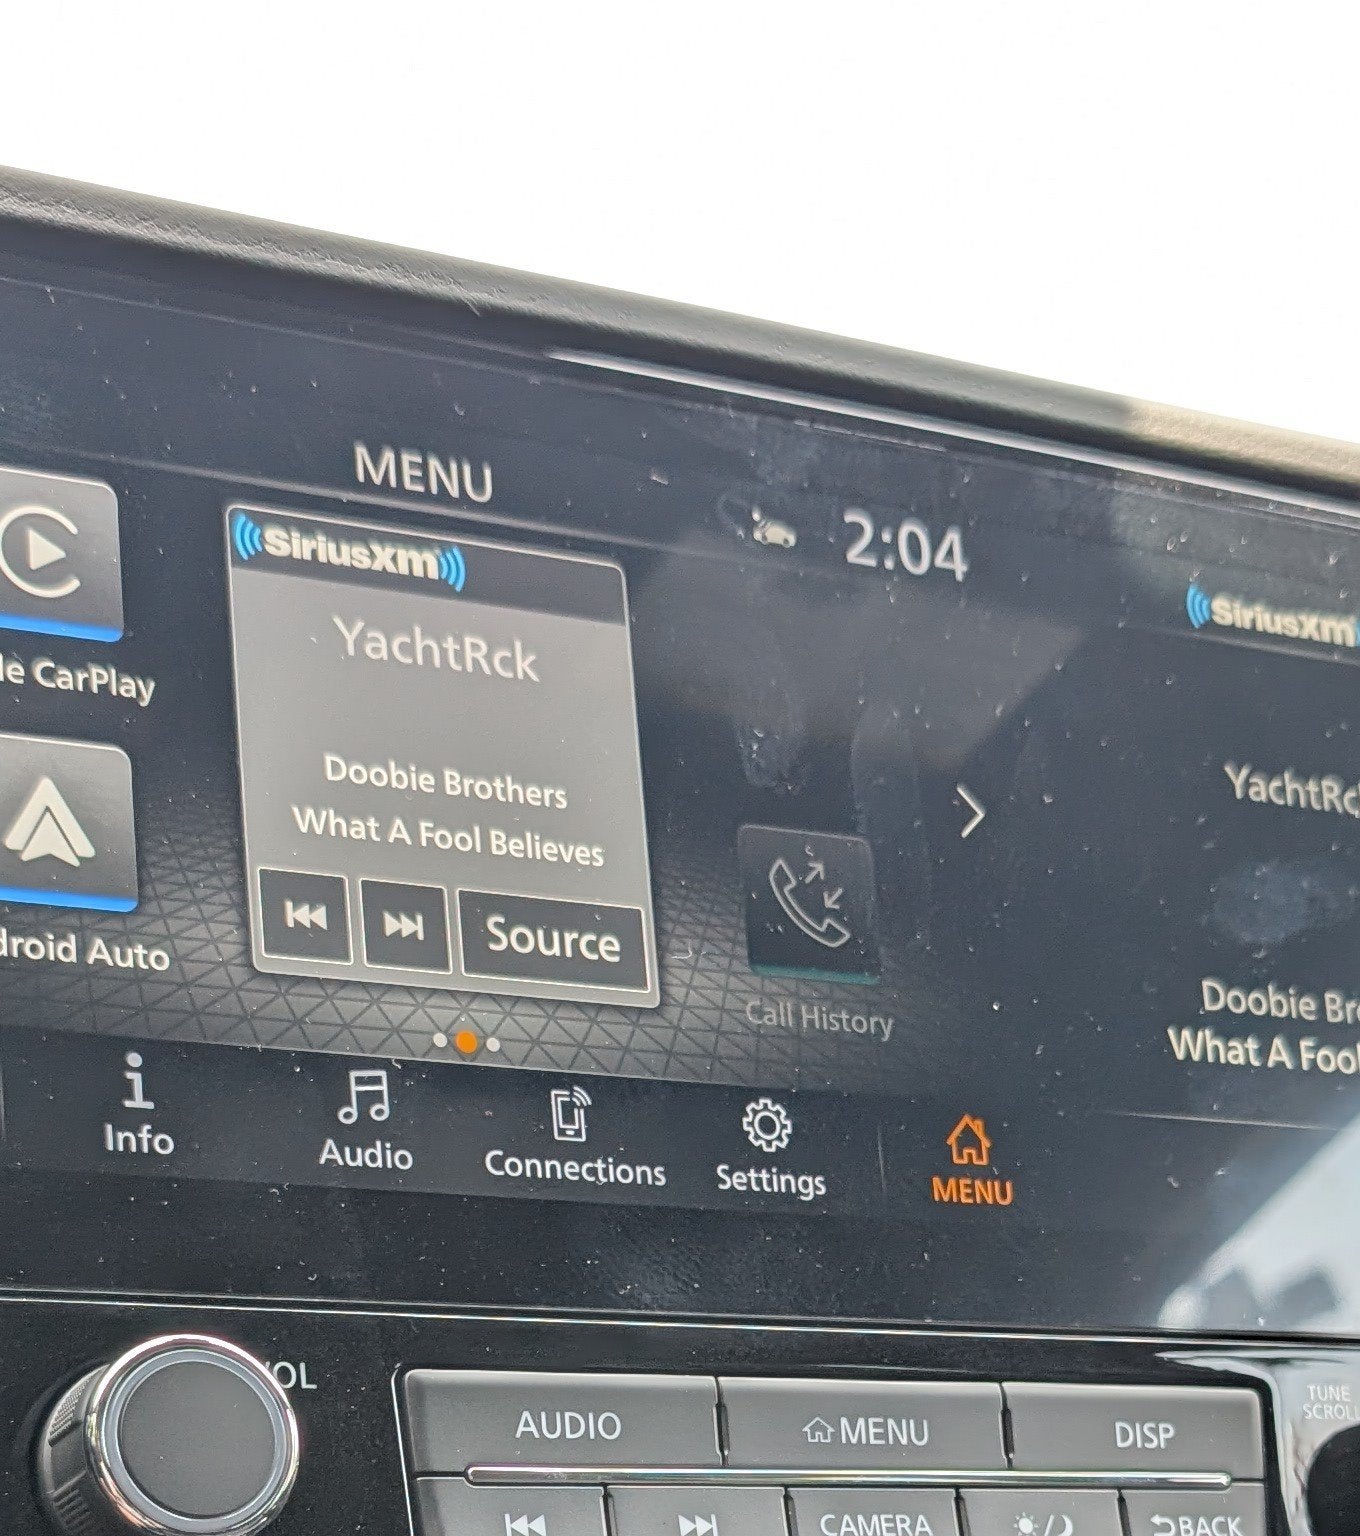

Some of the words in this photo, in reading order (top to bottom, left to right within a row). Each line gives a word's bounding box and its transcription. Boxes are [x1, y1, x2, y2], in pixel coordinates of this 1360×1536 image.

[353, 441, 493, 503] MENU
[842, 507, 969, 582] 2:04
[332, 615, 541, 683] YachtRck
[31, 657, 156, 707] CarPlay
[322, 752, 436, 794] Doobie
[442, 766, 569, 810] Brothers
[291, 804, 380, 843] What
[388, 819, 412, 847] A
[418, 821, 482, 854] Fool
[490, 828, 606, 868] Believes
[86, 935, 172, 972] Auto
[485, 913, 622, 964] Source
[1200, 976, 1317, 1022] Doobie
[744, 998, 793, 1028] Call
[802, 1003, 894, 1043] History
[1166, 1022, 1262, 1067] What
[1266, 1033, 1293, 1070] A
[104, 1123, 175, 1156] Info
[318, 1138, 414, 1171] Audio
[484, 1149, 668, 1188] Connections
[716, 1162, 828, 1202] Settings
[931, 1175, 1015, 1206] MENU
[264, 1360, 318, 1390] OL
[1306, 1383, 1353, 1402] TUNE
[514, 1409, 623, 1441] AUDIO
[1302, 1402, 1360, 1421] SCROLL
[839, 1416, 931, 1448] MENU
[1114, 1420, 1176, 1450] DISP
